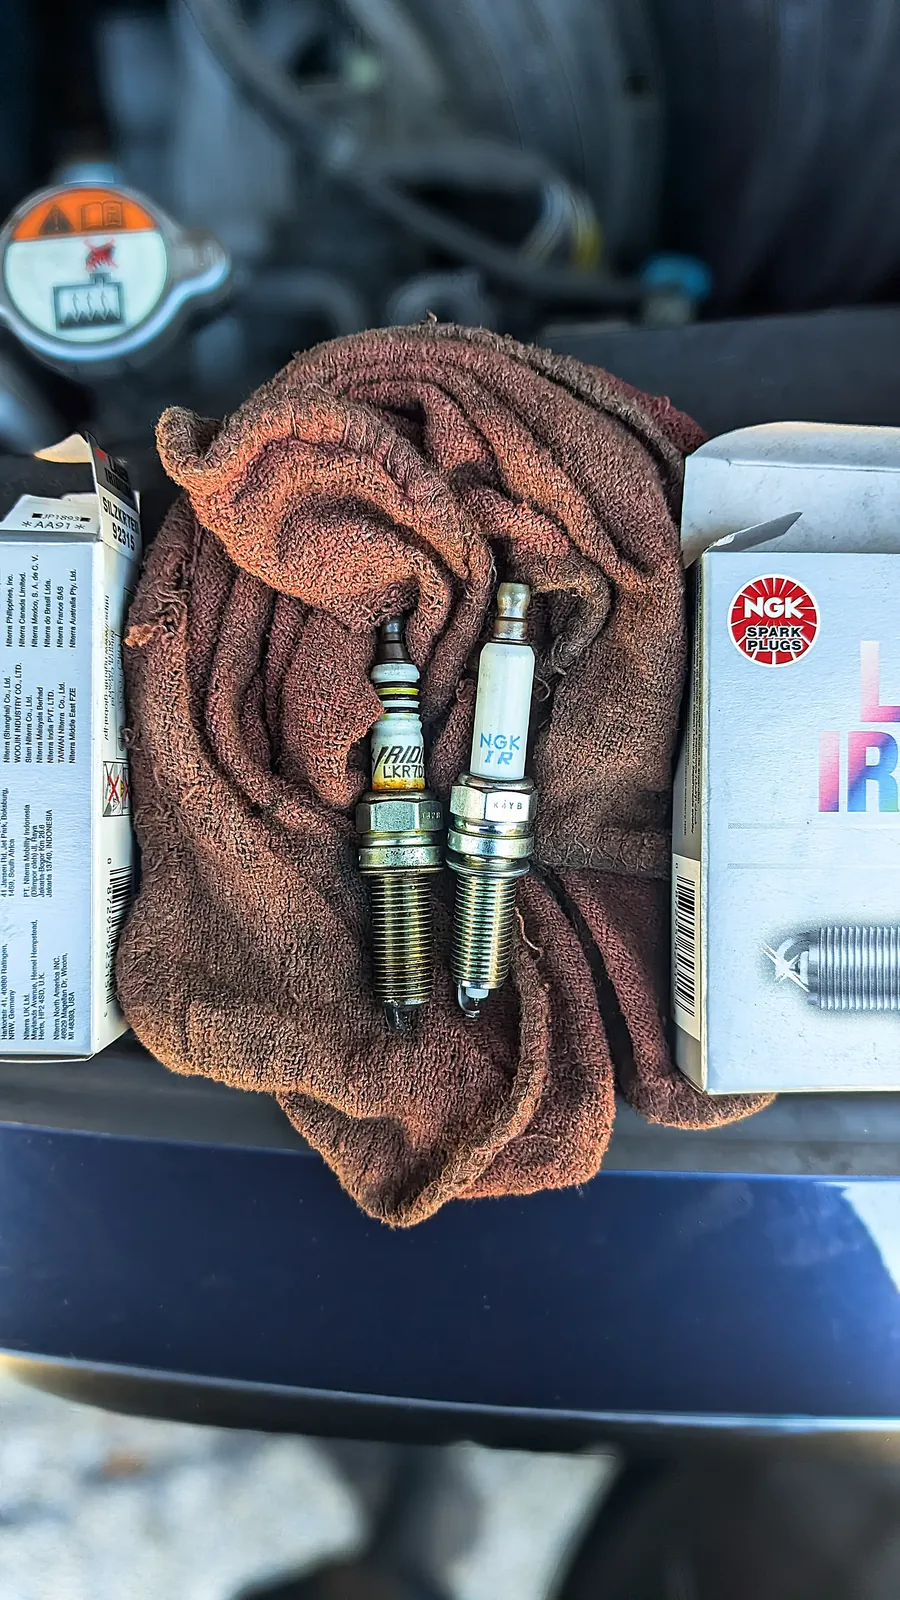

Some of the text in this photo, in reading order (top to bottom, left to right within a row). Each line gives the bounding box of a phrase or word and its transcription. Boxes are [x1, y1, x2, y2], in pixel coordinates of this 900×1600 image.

[112, 522, 135, 551] 92315
[31, 599, 39, 624] Mexico,
[744, 597, 804, 619] NGK
[746, 626, 802, 638] SPARK
[747, 640, 802, 651] PLUGS
[860, 640, 900, 723] L
[36, 712, 44, 740] Malaysia
[480, 733, 521, 751] NGK
[383, 765, 425, 778] LKR7D
[818, 731, 899, 812] IR
[61, 989, 69, 1018] Magellan
